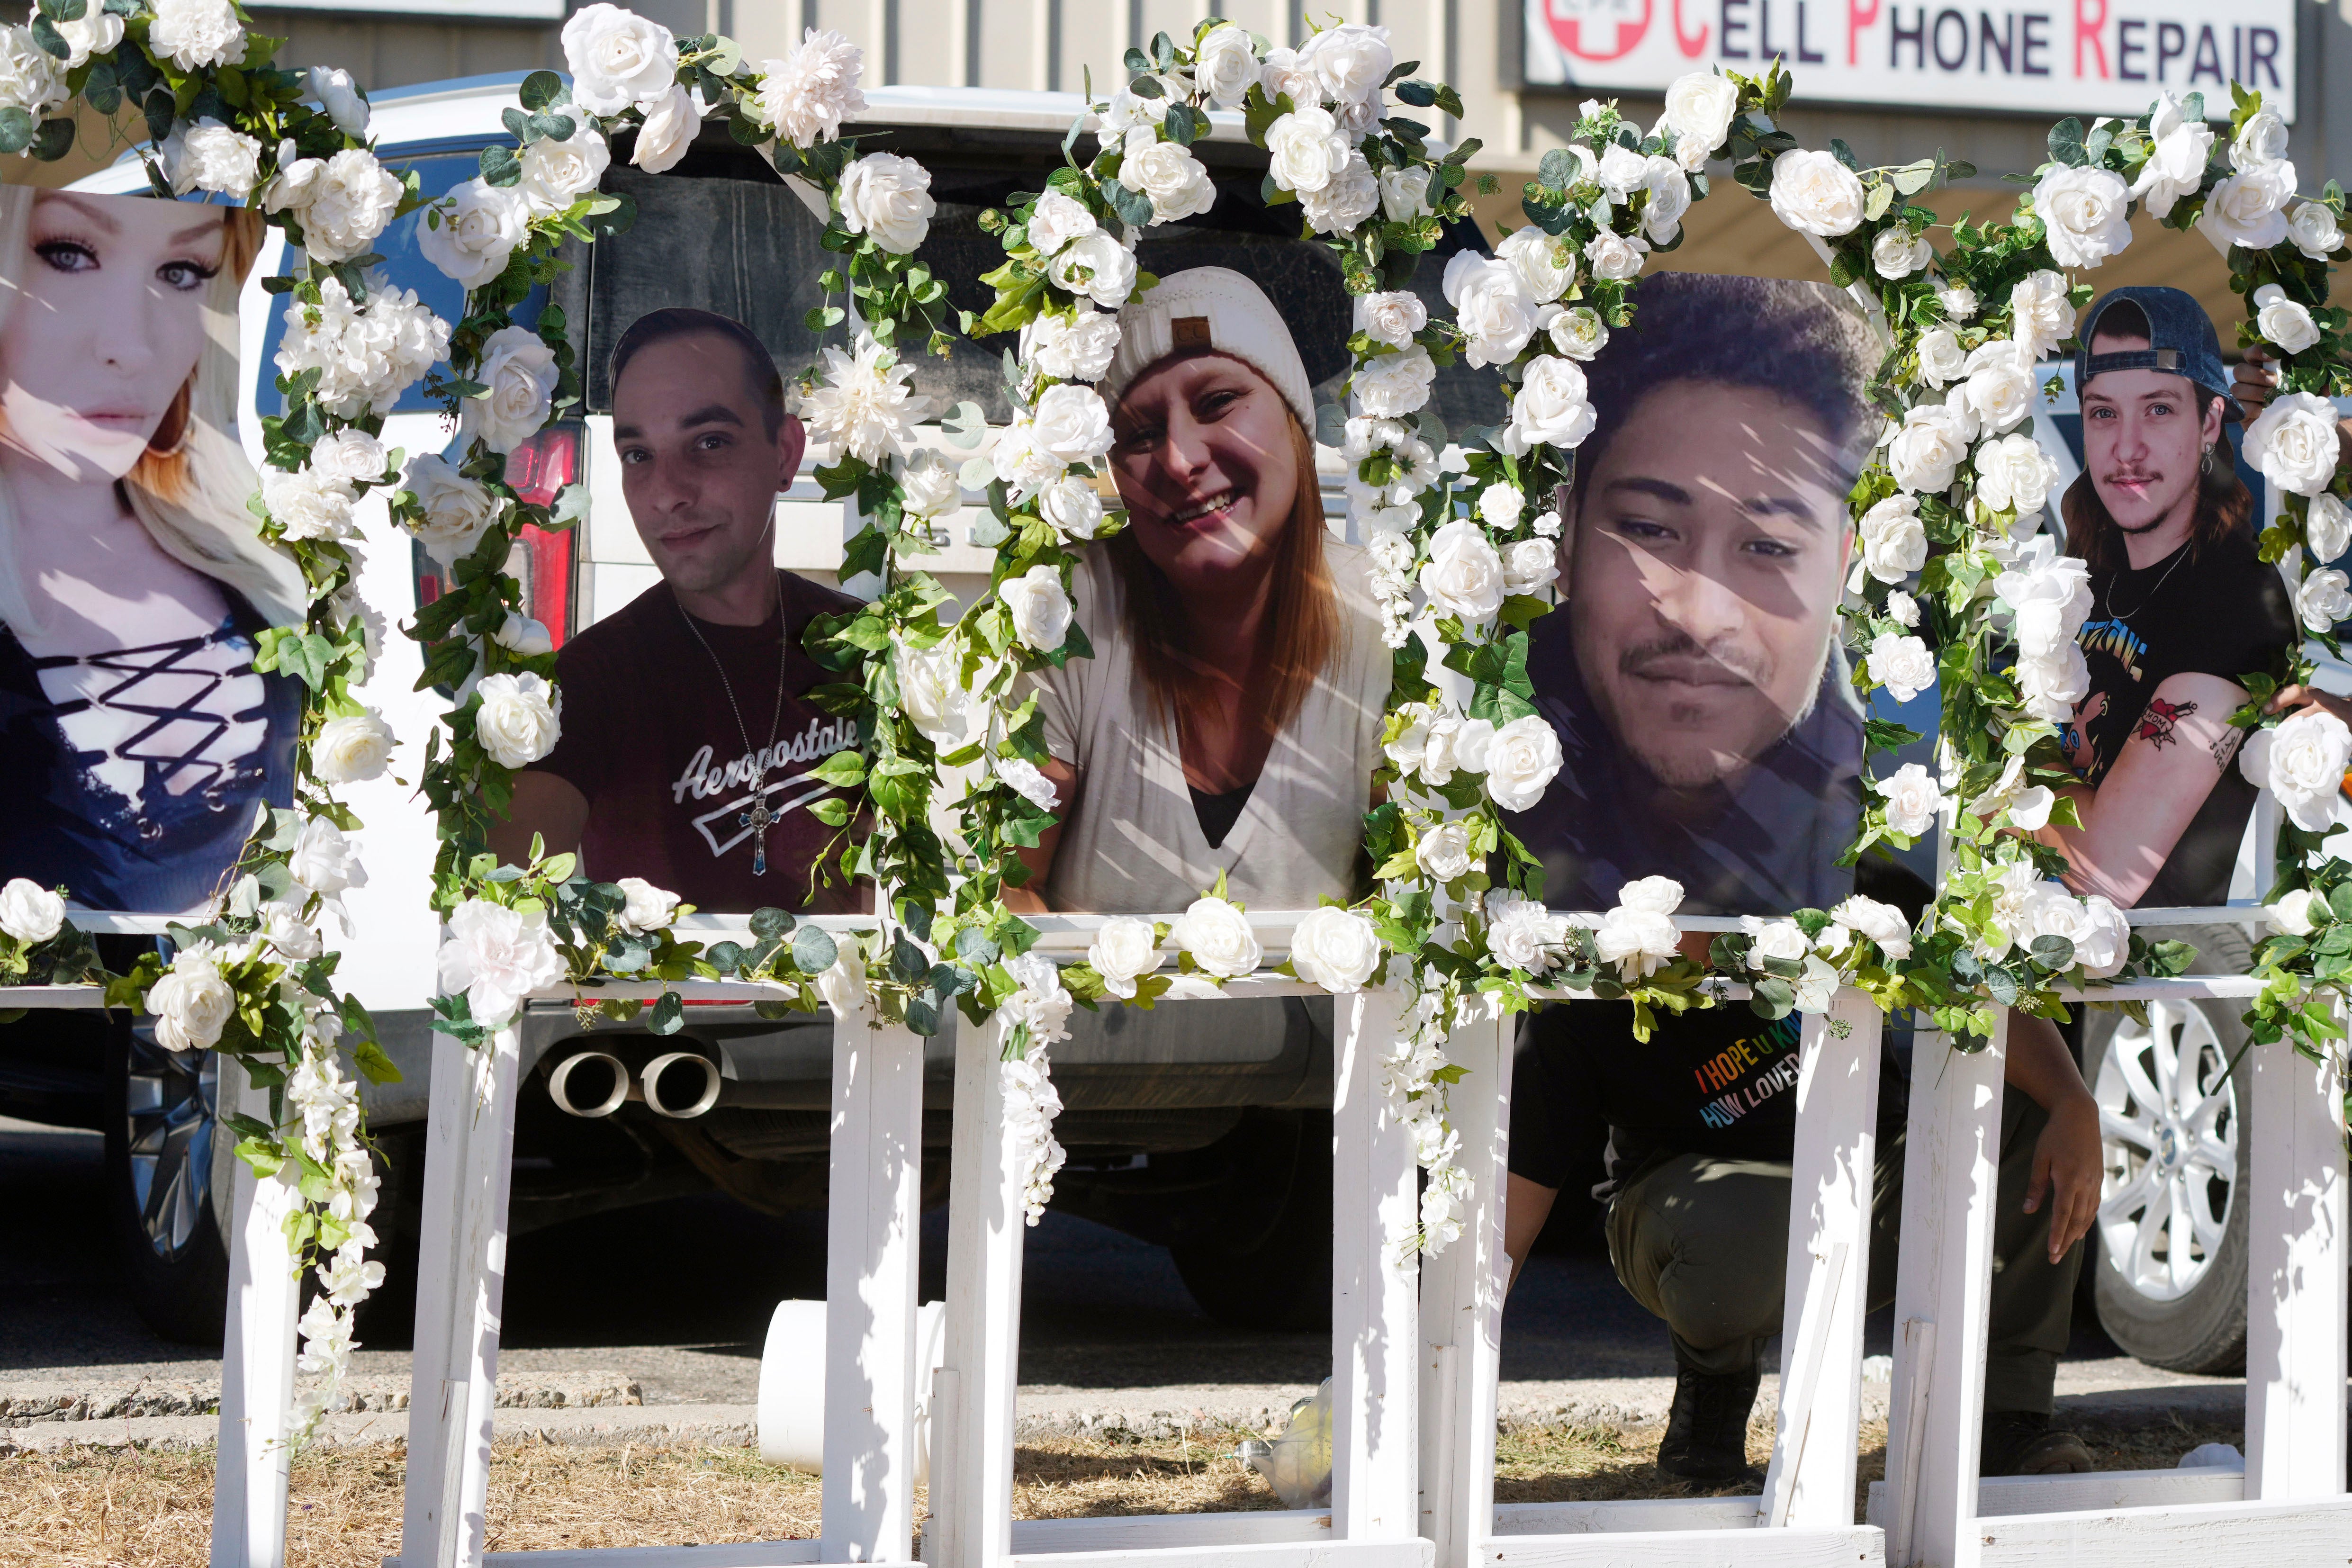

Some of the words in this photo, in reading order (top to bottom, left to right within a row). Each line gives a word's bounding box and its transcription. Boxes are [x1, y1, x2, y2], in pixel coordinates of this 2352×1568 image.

[1849, 0, 2049, 75] PHONE
[2074, 0, 2281, 88] REPAIR
[2145, 712, 2166, 728] MOM
[1694, 1069, 1708, 1094] I
[1702, 1039, 1758, 1090] HOPE
[1699, 1093, 1747, 1128] HOW
